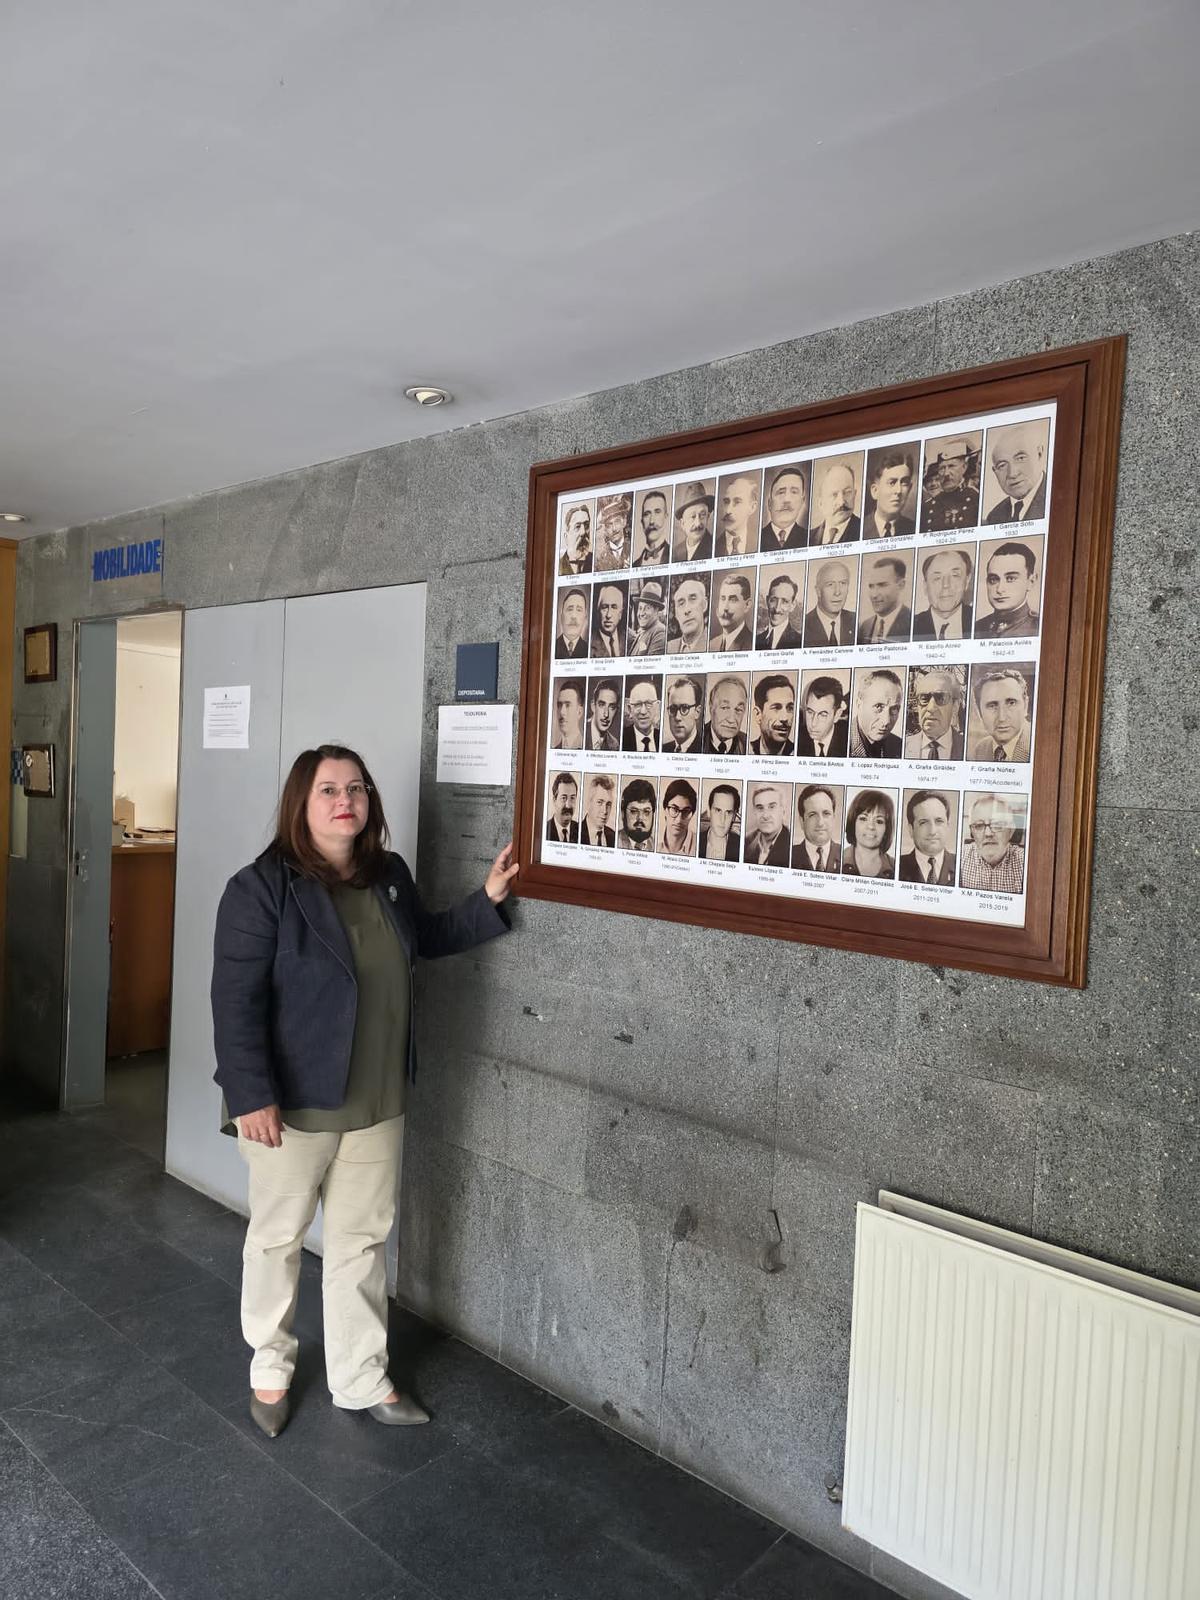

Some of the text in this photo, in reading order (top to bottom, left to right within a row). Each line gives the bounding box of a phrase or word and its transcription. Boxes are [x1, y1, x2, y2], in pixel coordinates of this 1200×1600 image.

[93, 539, 161, 582] MOBILIDADE
[996, 766, 1016, 774] Núñez
[976, 891, 994, 900] Pazos
[995, 892, 1014, 902] Varela
[979, 902, 1008, 912] 2015-2019
